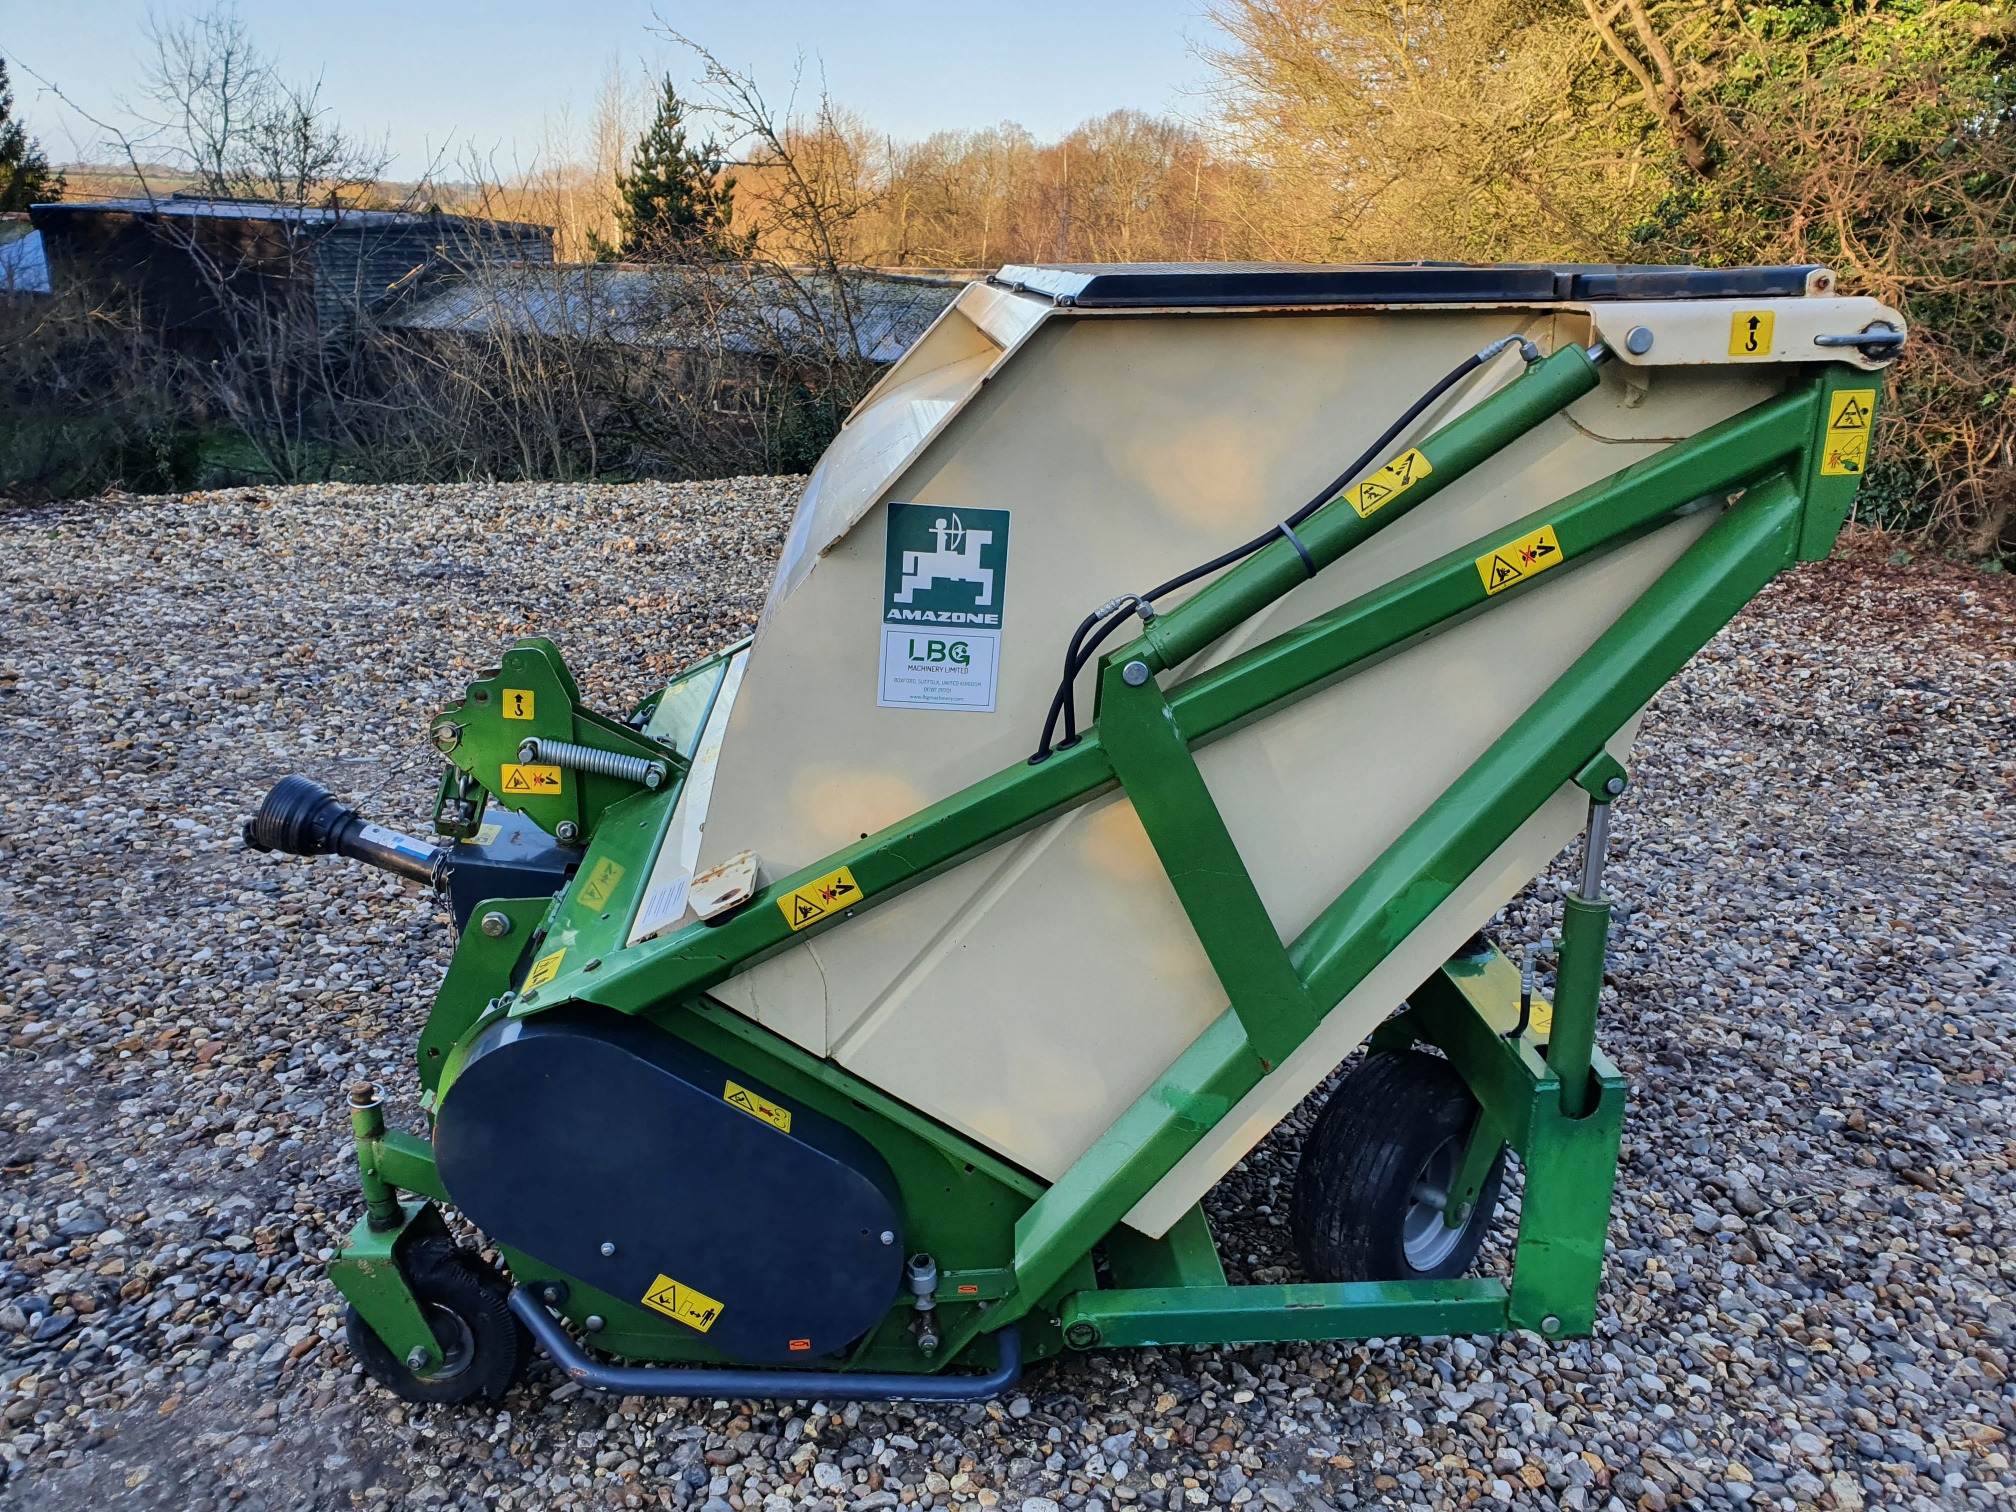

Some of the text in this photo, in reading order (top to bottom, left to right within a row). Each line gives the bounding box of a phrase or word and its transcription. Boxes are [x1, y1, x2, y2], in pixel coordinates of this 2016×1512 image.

[887, 608, 999, 625] AMAZONE
[908, 639, 971, 667] LBG
[907, 665, 944, 673] MACHINERY
